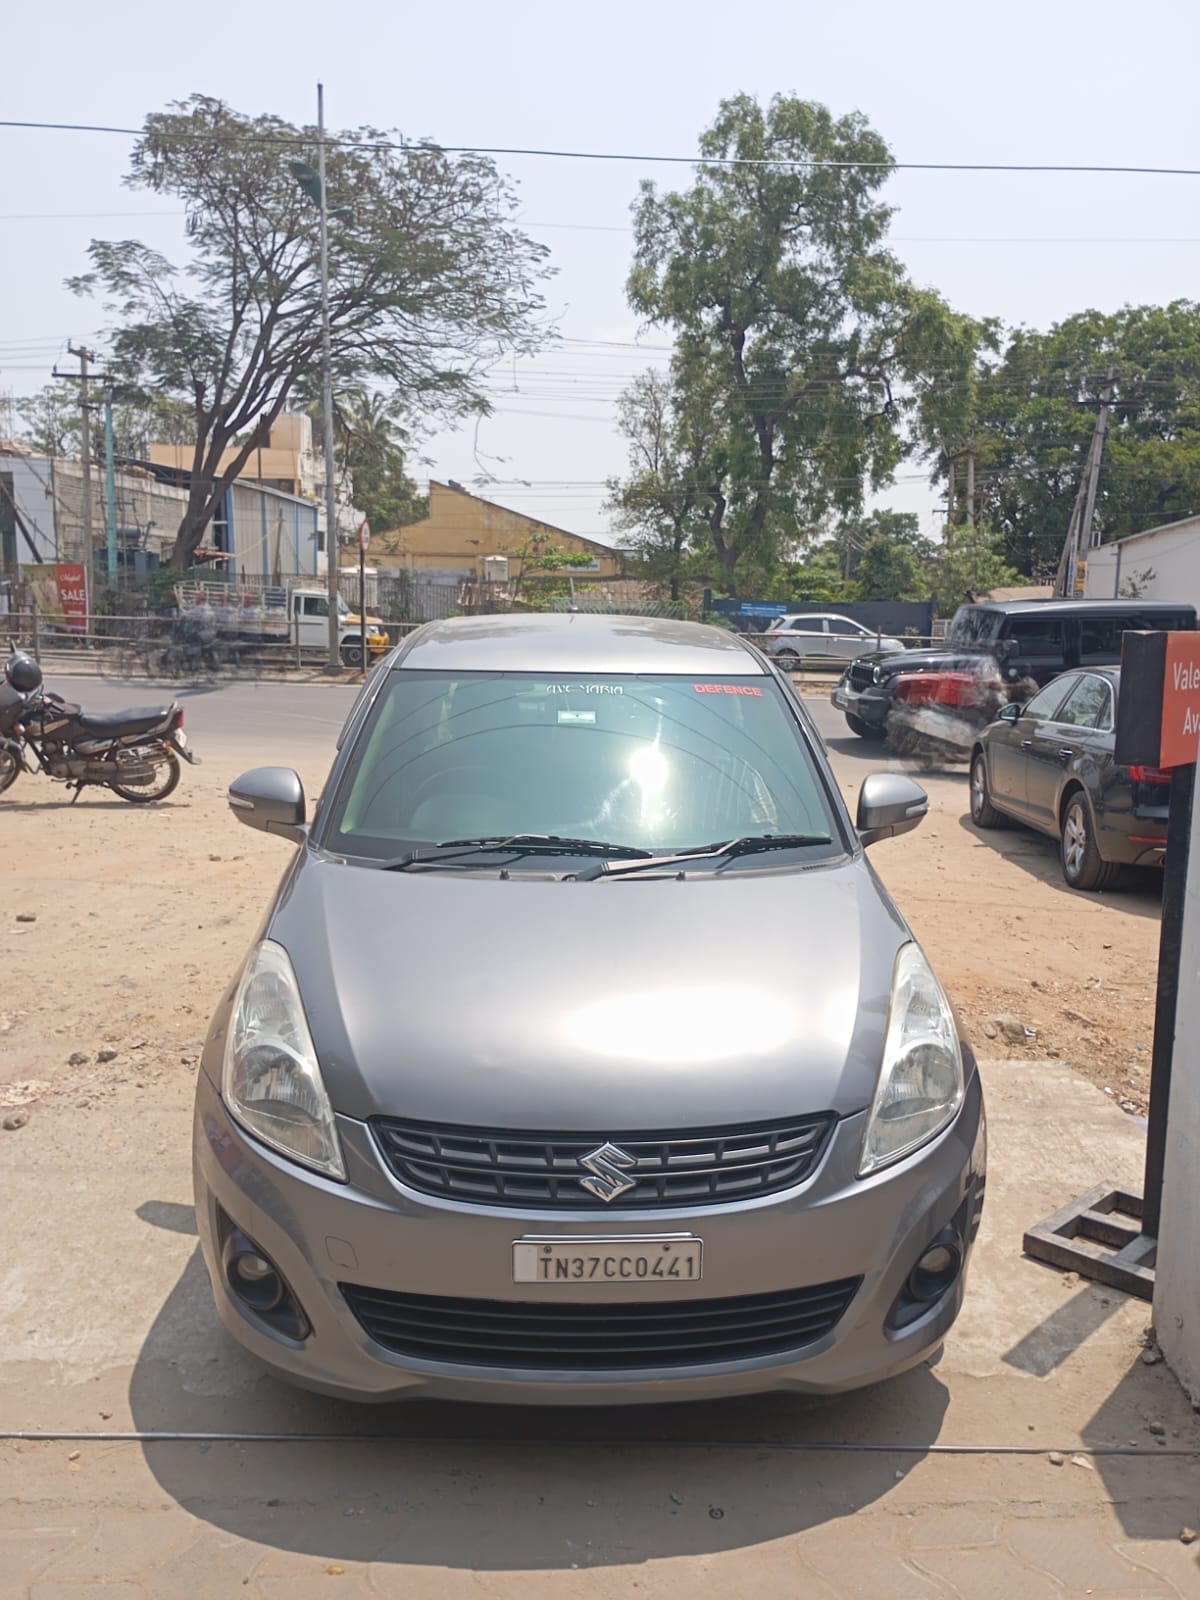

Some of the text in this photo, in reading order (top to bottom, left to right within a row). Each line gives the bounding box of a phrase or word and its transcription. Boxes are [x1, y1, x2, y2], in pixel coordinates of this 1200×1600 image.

[61, 589, 85, 601] SALE
[694, 684, 763, 697] DEFENCE
[1182, 706, 1200, 735] Av
[540, 1256, 694, 1279] TN37CC0441
